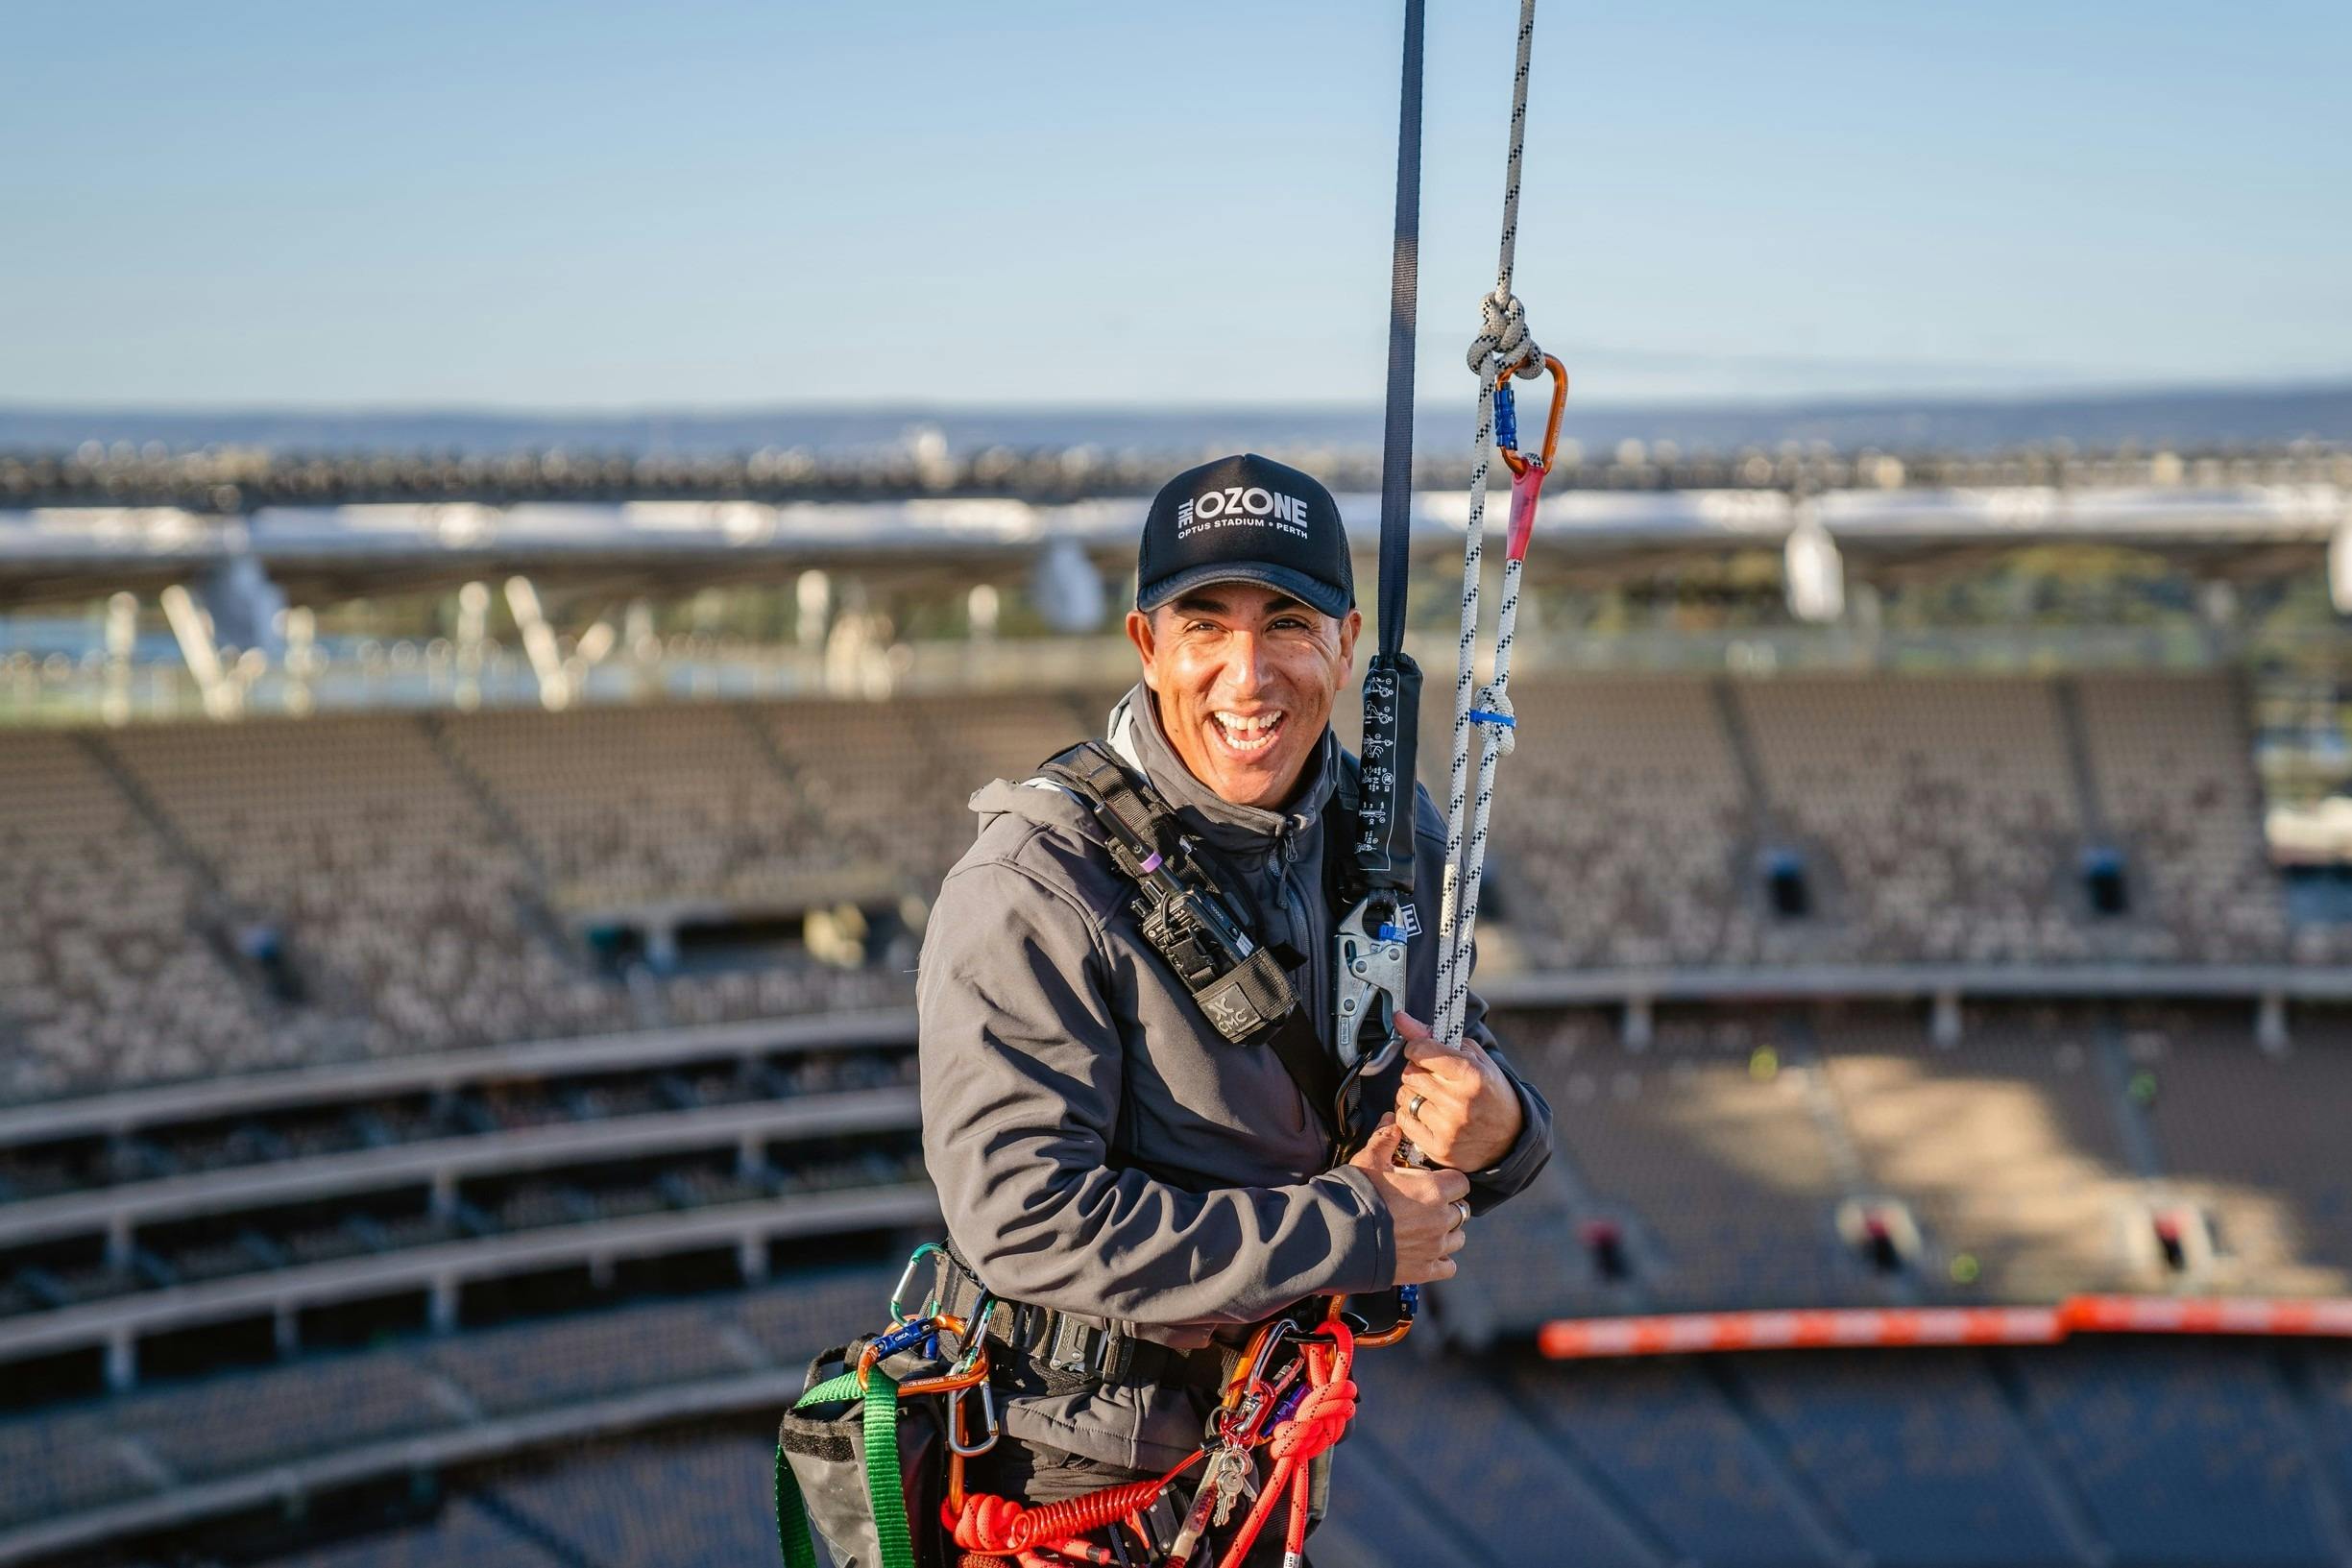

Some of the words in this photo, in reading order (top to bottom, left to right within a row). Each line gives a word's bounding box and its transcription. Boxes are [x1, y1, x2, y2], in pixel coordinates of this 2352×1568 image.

[1177, 498, 1194, 529] THE
[1195, 487, 1308, 528] OZONE
[1177, 522, 1211, 540] OPTUS
[1214, 519, 1265, 528] STADIUM
[1276, 522, 1308, 540] PERTH
[1218, 1008, 1248, 1032] CMC
